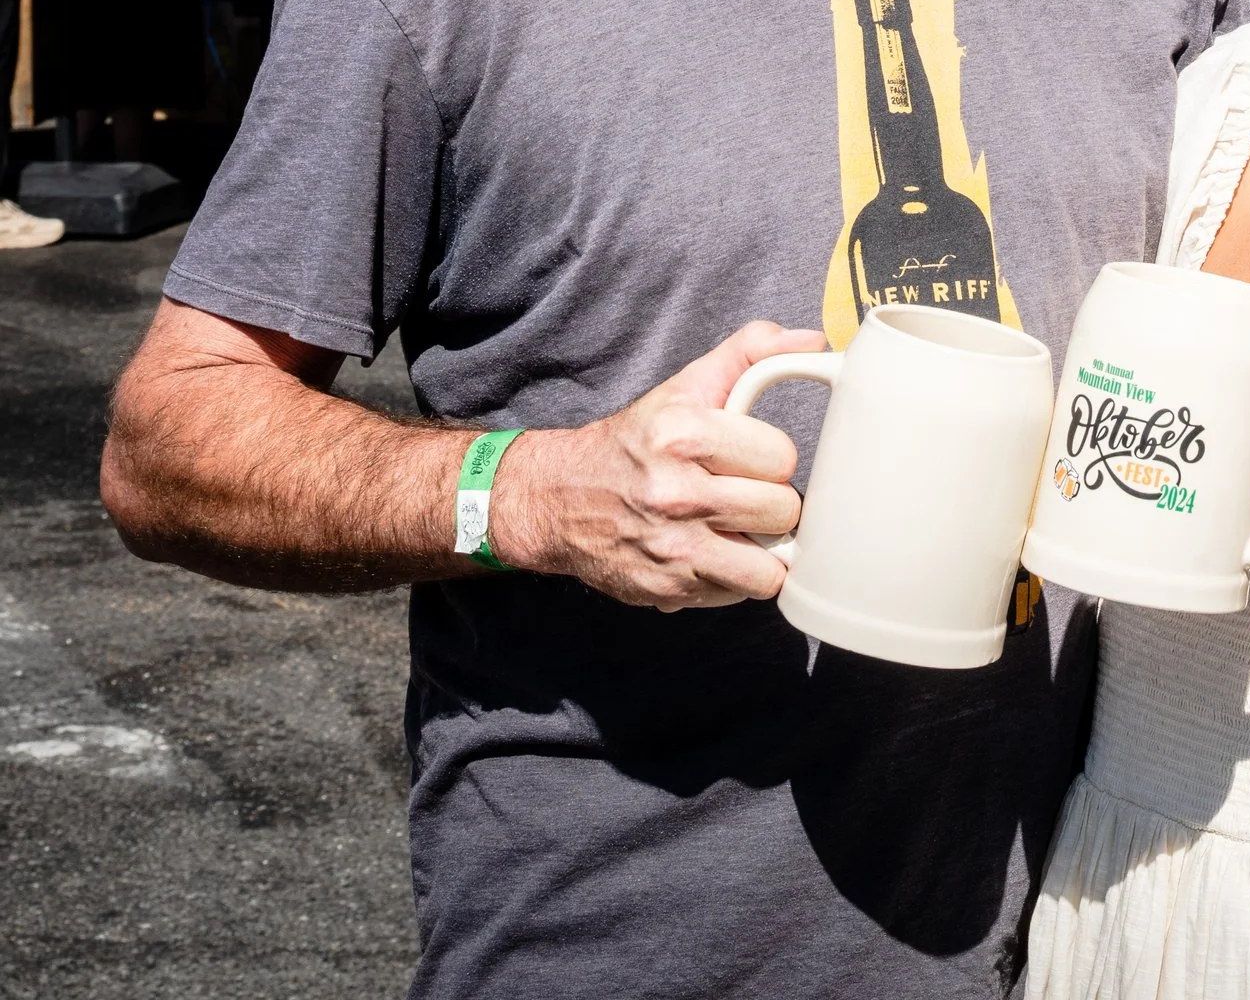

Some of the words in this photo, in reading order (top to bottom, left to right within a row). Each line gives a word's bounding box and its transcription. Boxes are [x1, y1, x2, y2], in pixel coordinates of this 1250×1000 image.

[867, 285, 919, 308] NEW
[932, 279, 989, 303] RIFF
[1092, 358, 1104, 371] 9th
[1105, 363, 1134, 381] Annual
[1077, 366, 1122, 396] Mountain
[1126, 382, 1156, 405] View
[1067, 394, 1205, 464] Oktober
[1124, 461, 1165, 488] FEST
[1156, 484, 1197, 514] 2024
